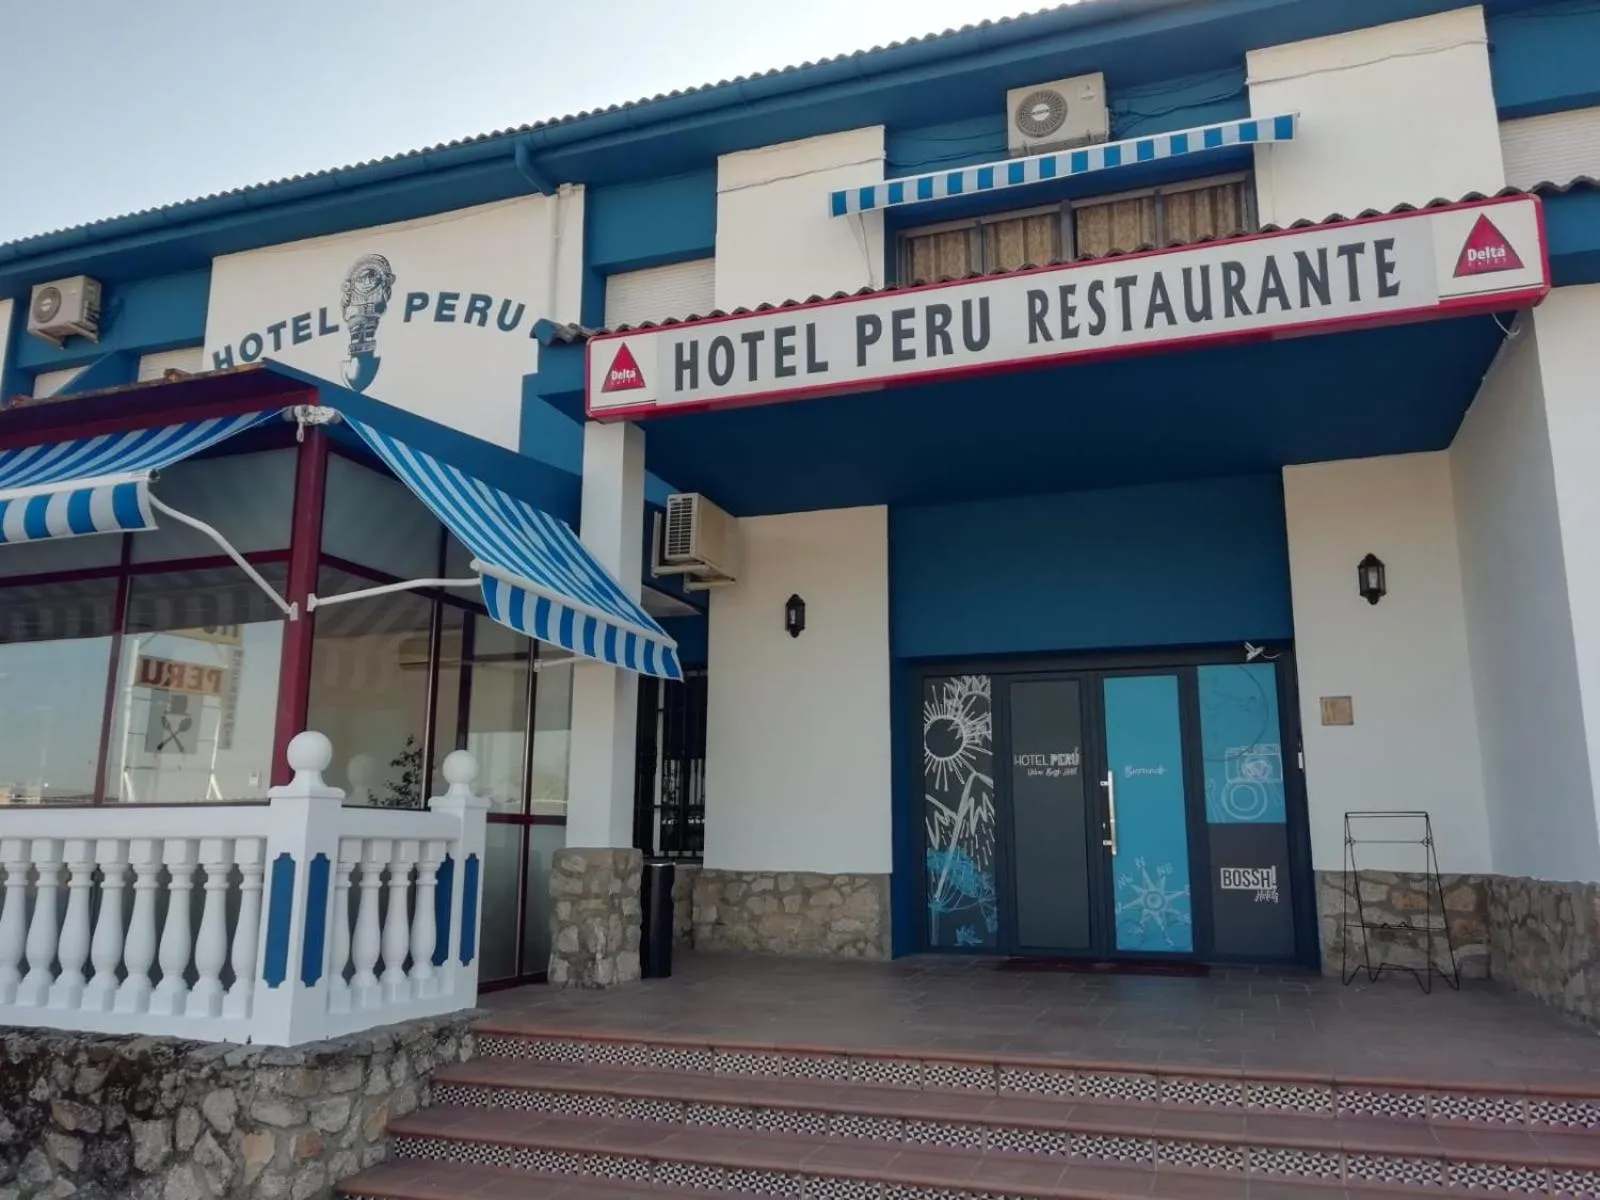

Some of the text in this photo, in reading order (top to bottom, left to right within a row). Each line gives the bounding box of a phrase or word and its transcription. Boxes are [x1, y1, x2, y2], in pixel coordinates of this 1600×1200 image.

[1467, 245, 1506, 262] Delta
[674, 237, 1401, 392] HOTEL PERU RESTAURANTE
[212, 292, 525, 371] HOTEL PERU
[1013, 754, 1049, 766] HOTEL
[1222, 865, 1277, 888] BOSSH!
